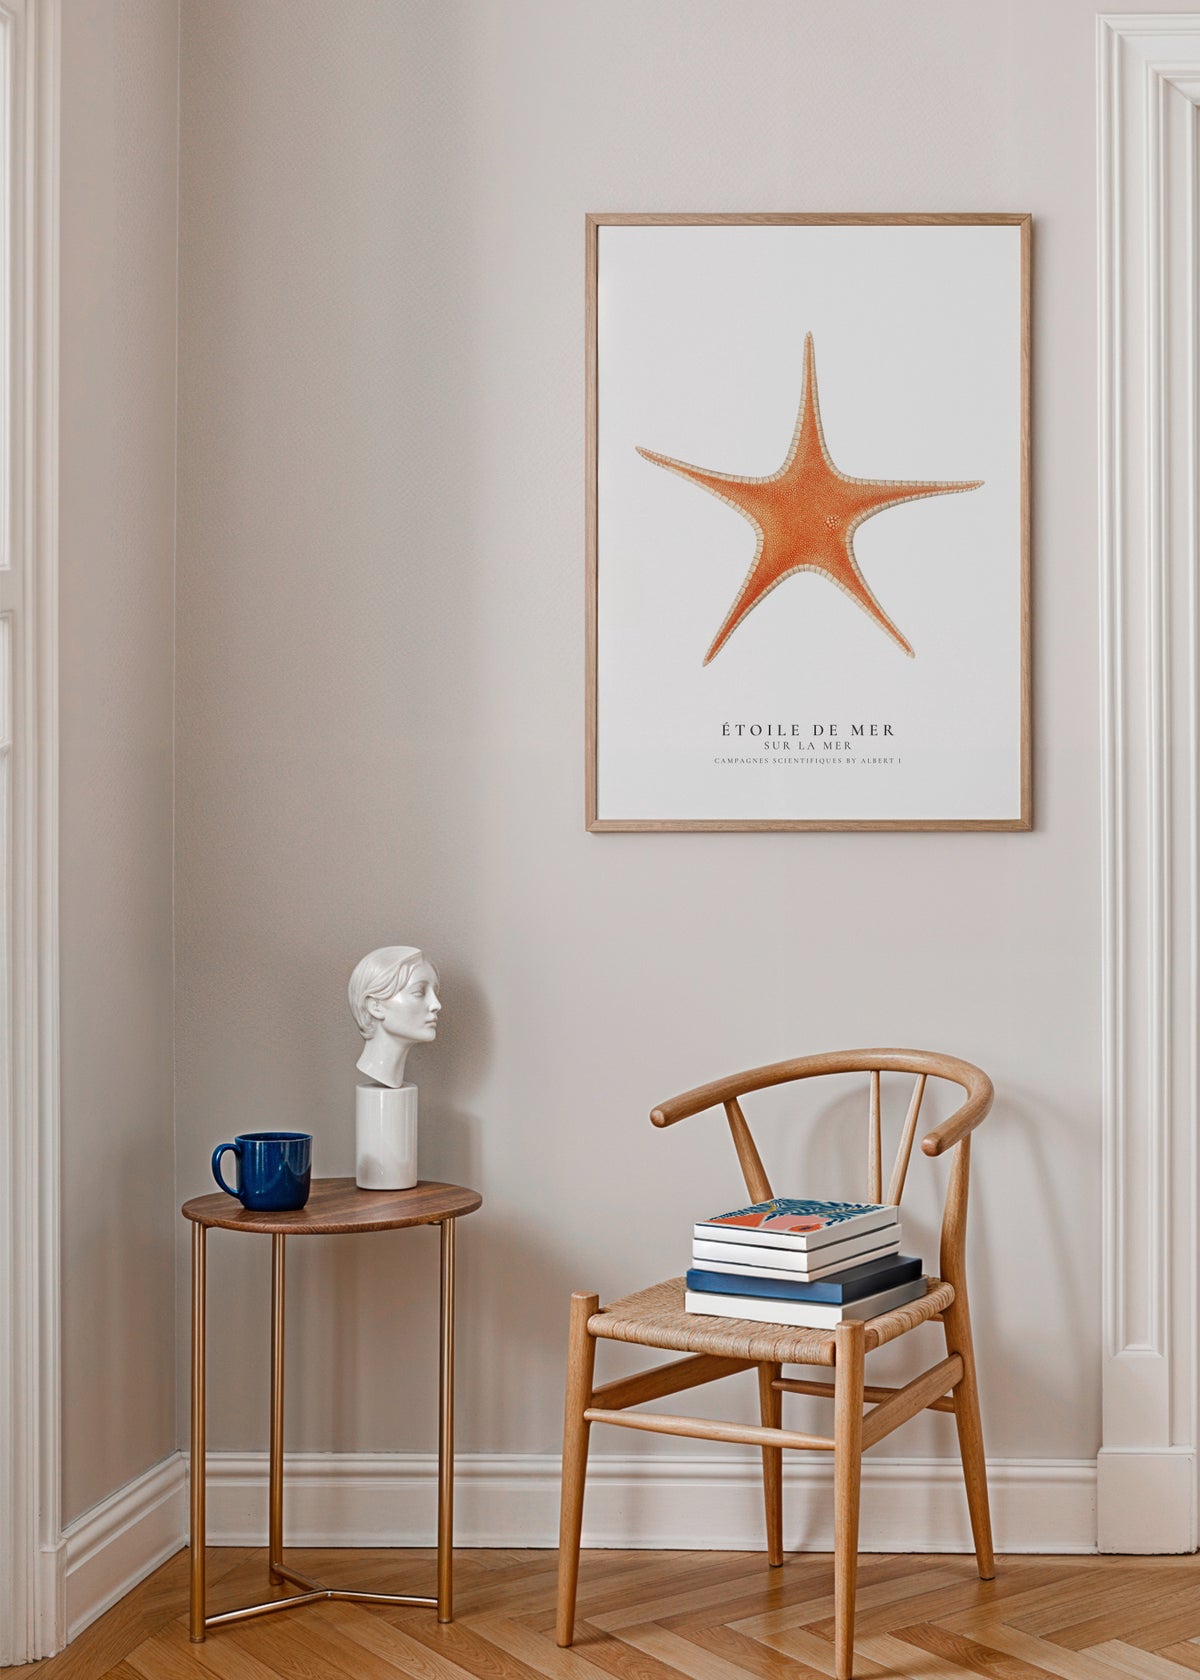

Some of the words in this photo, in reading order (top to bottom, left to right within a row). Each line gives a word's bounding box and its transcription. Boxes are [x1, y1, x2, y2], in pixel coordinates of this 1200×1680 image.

[722, 721, 800, 736] ÉTOILE
[813, 724, 838, 736] DE
[851, 724, 895, 736] MER
[764, 741, 791, 750] SUR
[798, 741, 816, 750] LA
[823, 741, 852, 750] MER
[773, 757, 842, 765] SCIENTIFIQUES
